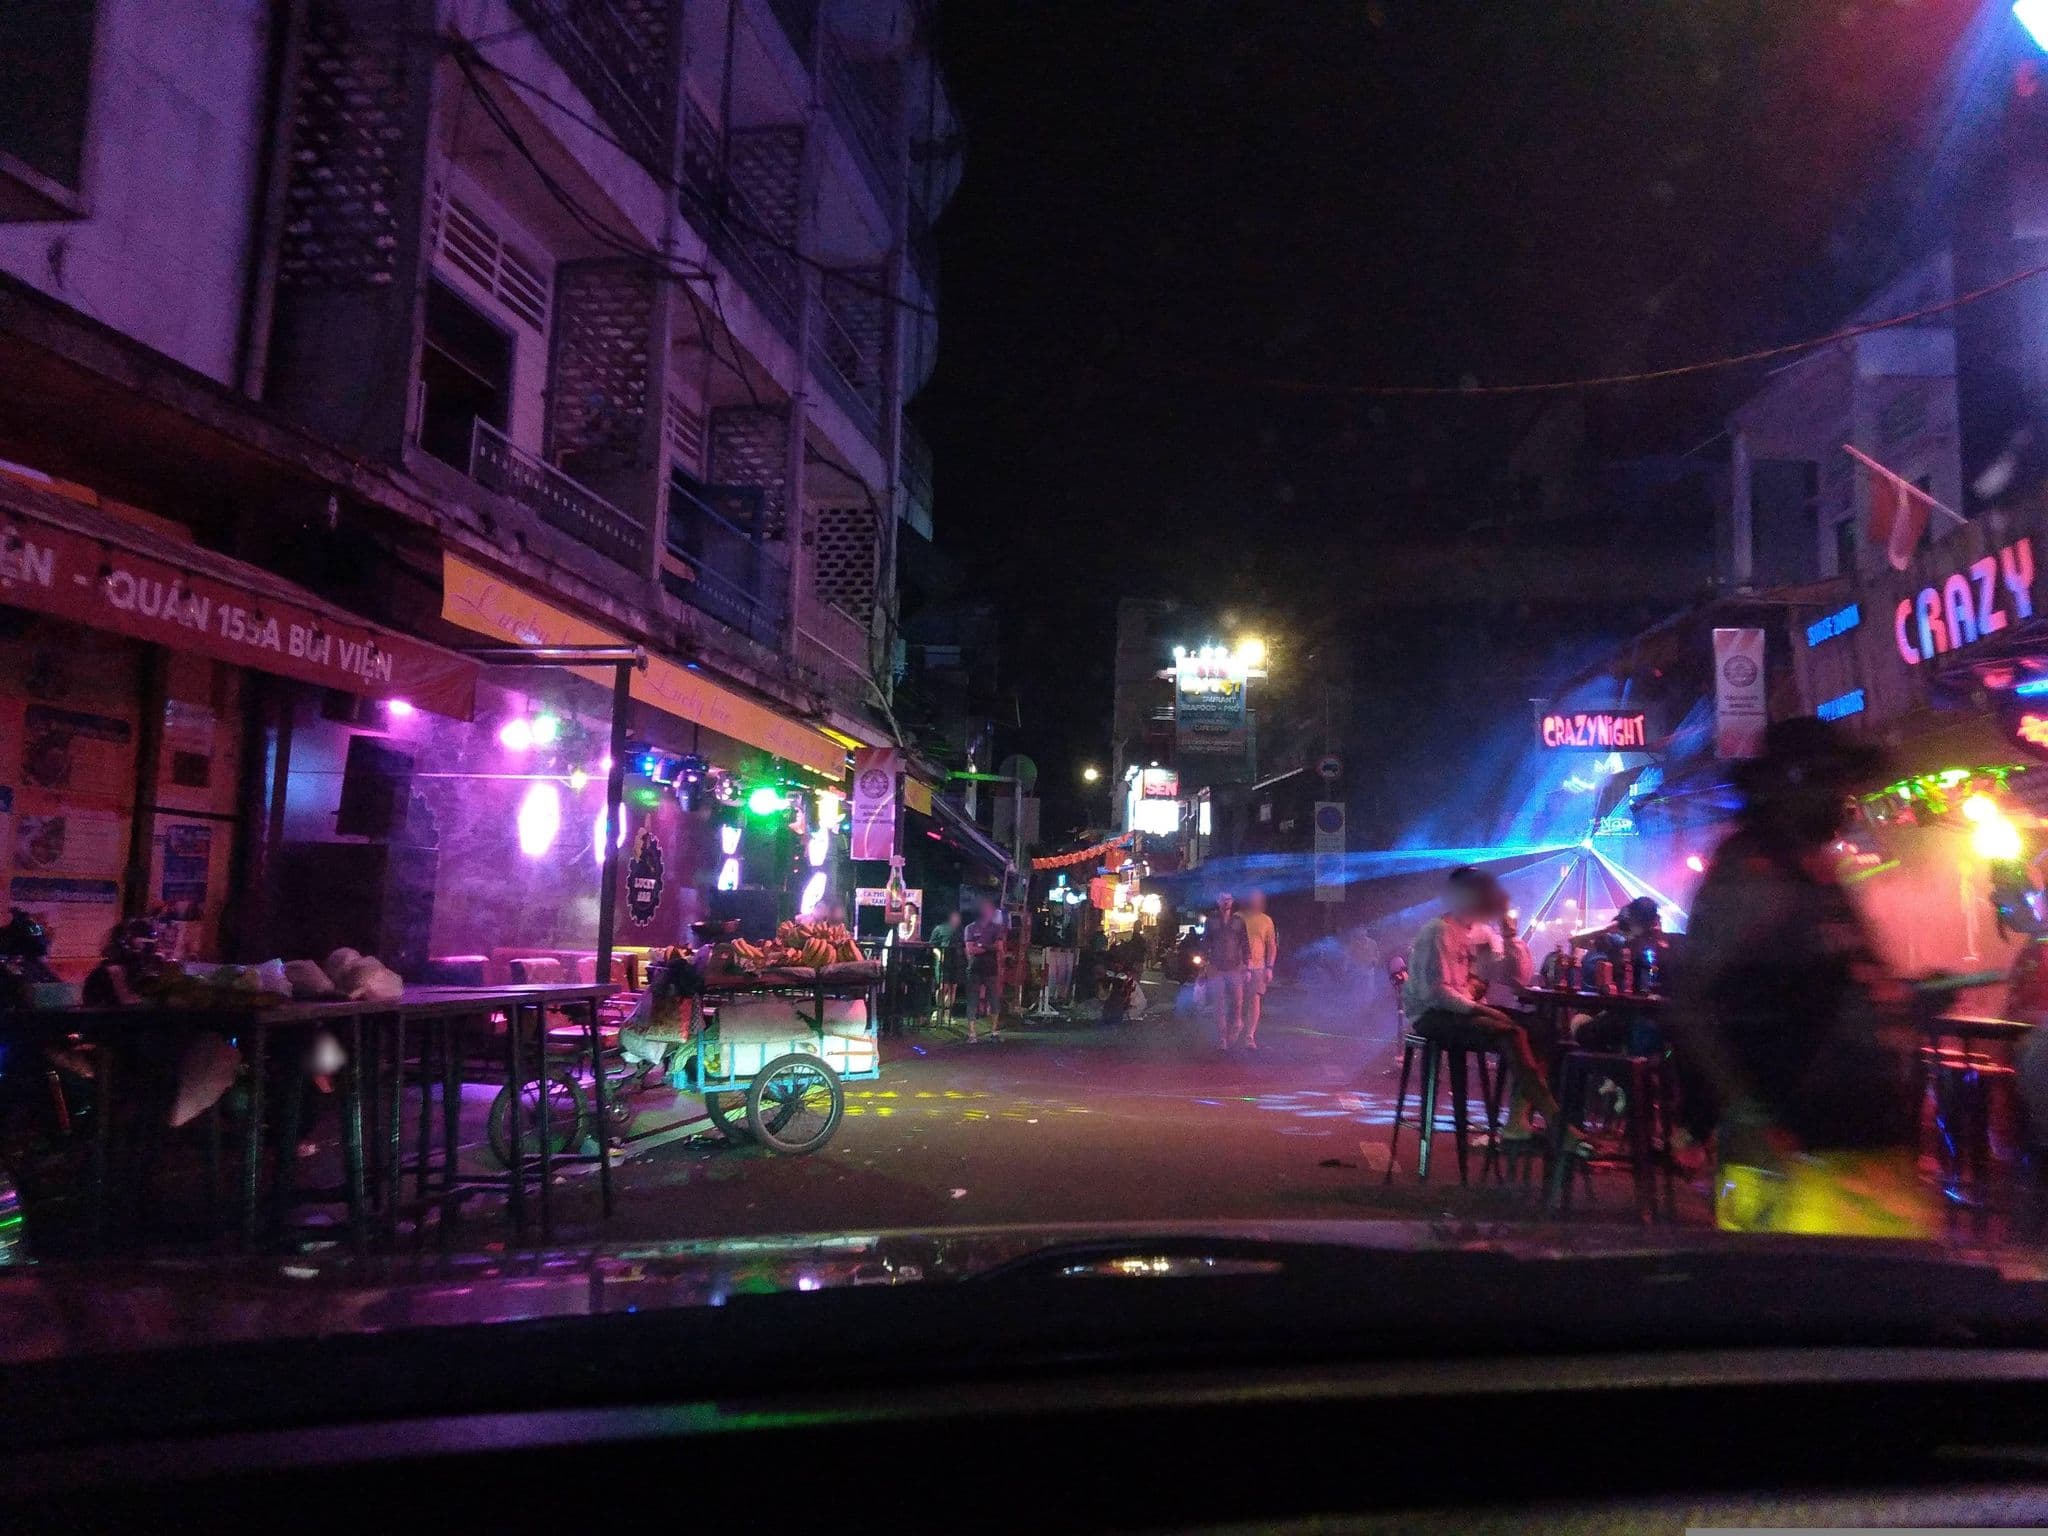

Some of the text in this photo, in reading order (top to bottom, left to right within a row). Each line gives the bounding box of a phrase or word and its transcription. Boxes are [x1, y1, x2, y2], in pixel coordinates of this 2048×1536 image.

[72, 572, 89, 585] -
[1894, 537, 2035, 666] CRAZY
[1145, 782, 1178, 797] SEN
